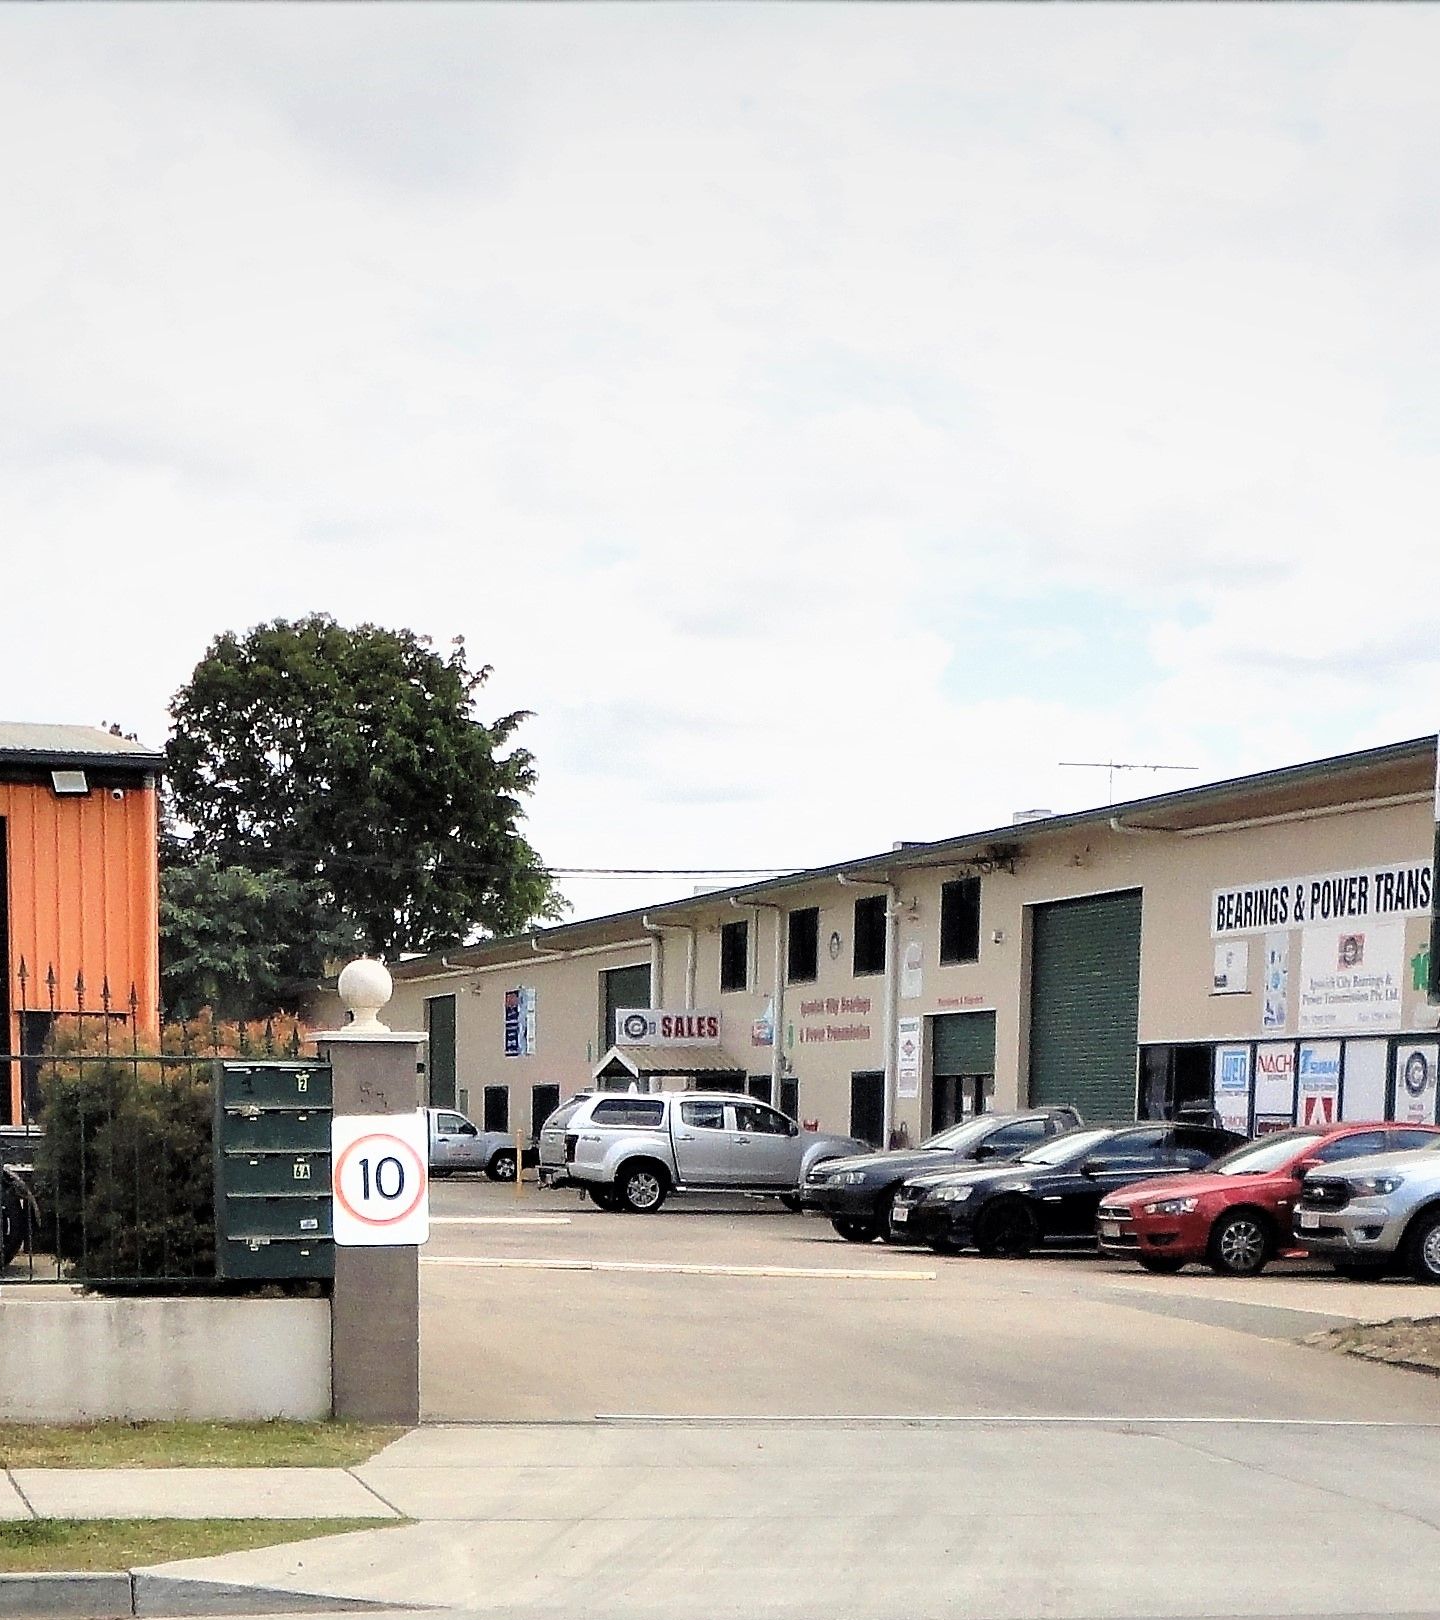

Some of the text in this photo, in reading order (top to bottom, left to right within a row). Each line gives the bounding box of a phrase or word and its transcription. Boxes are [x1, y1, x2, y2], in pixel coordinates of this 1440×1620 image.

[1216, 885, 1289, 932] BEARINGS
[1293, 884, 1306, 922] &
[1310, 875, 1369, 921] POWER
[662, 1015, 718, 1038] SALES
[358, 1156, 405, 1201] 10
